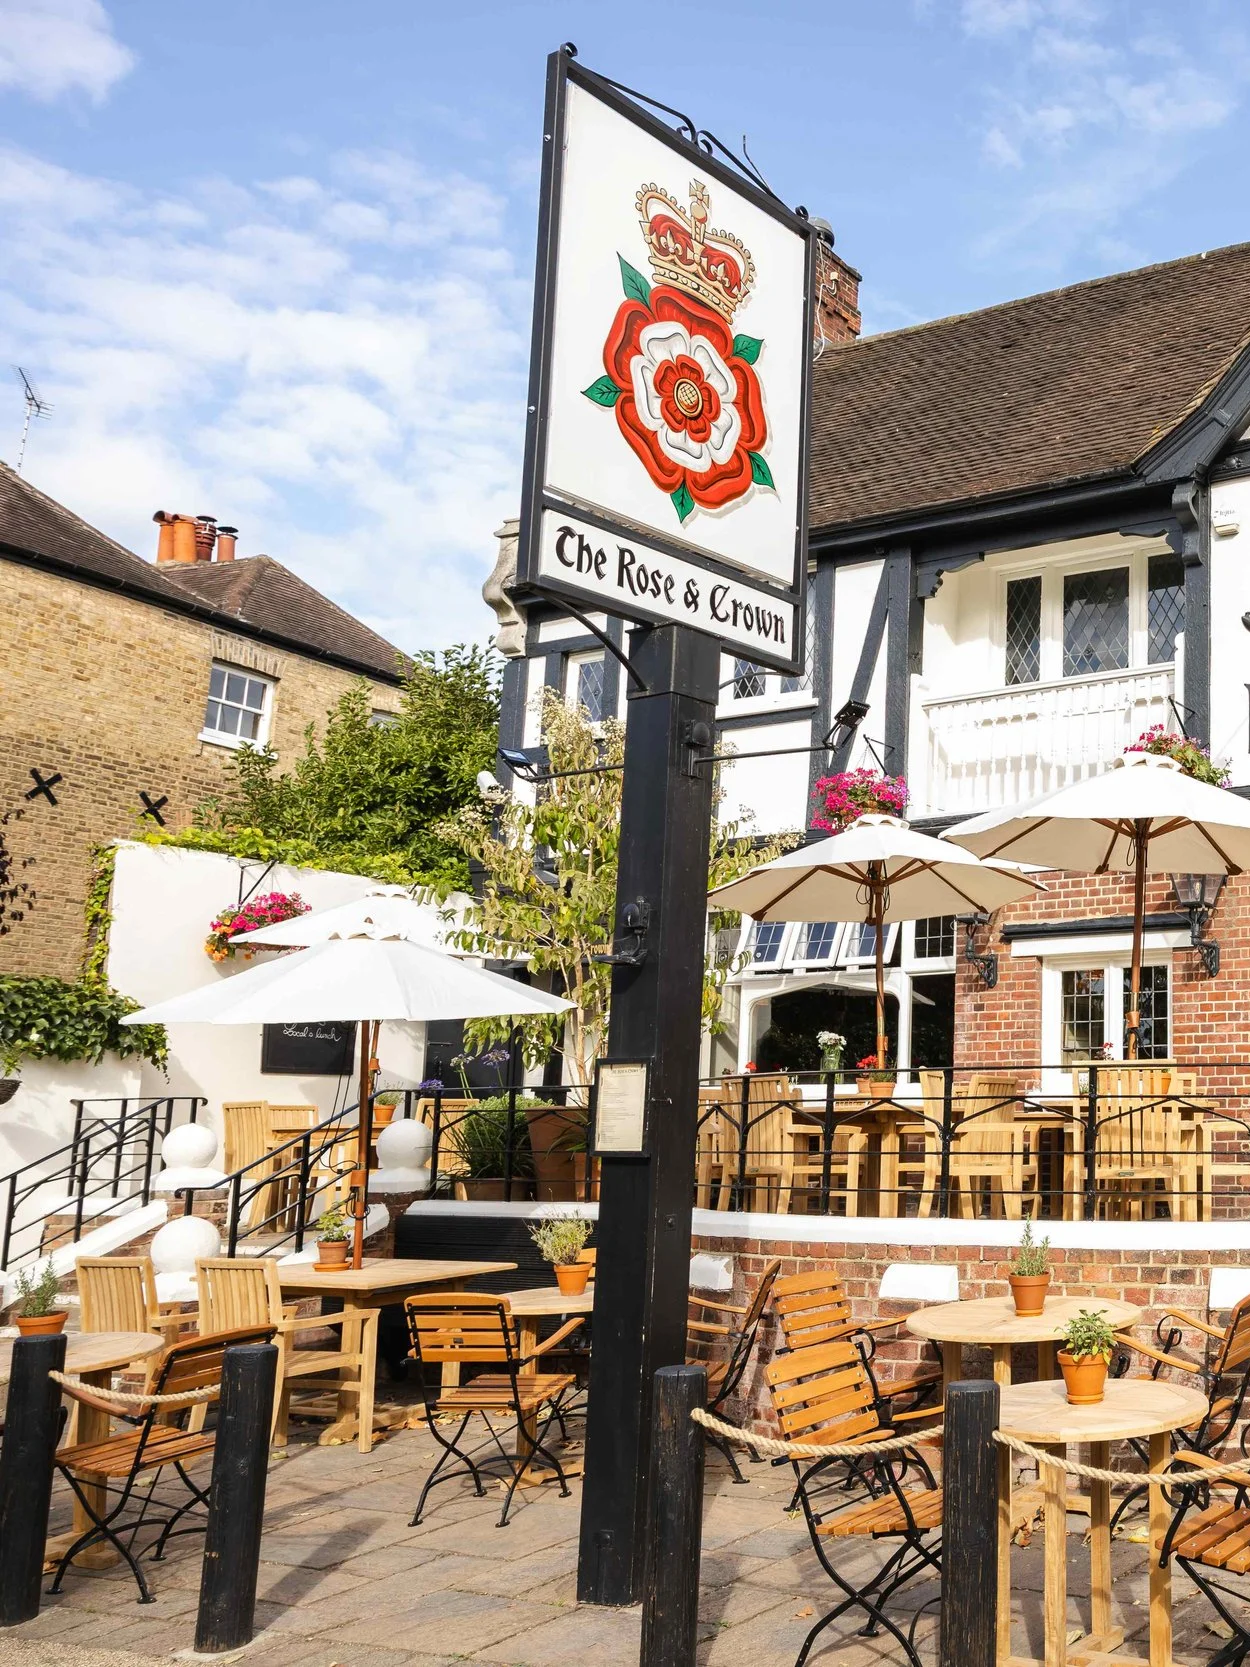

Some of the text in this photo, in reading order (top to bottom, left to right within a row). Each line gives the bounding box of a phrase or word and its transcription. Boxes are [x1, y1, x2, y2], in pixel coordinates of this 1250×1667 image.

[556, 525, 787, 643] The Rose & Crown
